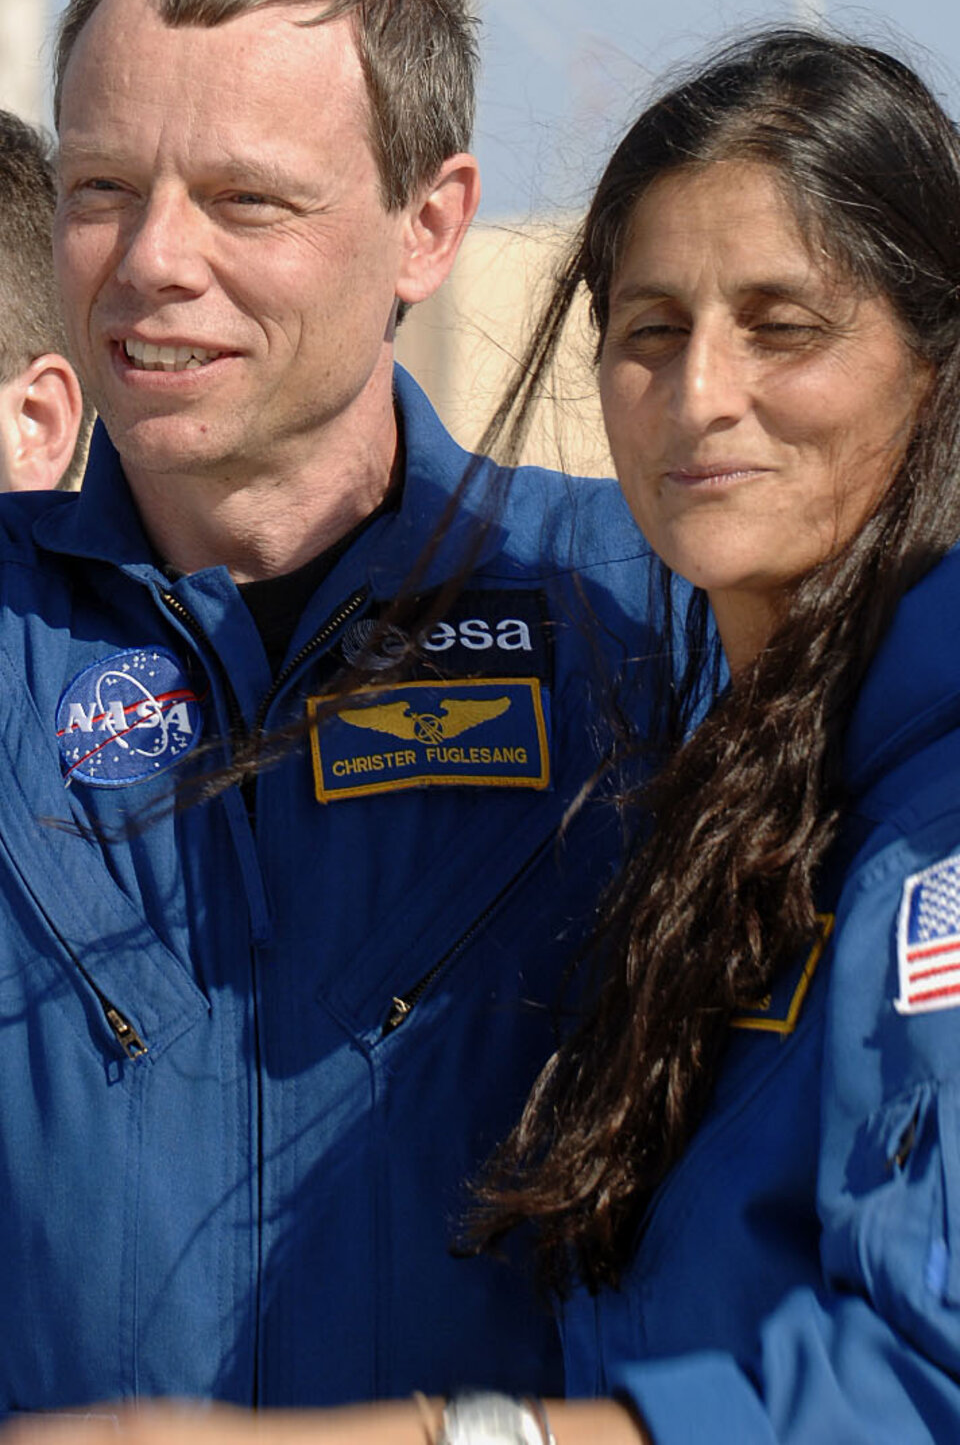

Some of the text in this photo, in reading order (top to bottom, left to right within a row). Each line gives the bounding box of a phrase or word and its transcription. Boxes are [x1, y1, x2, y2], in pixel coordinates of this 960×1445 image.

[420, 619, 533, 651] esa
[65, 701, 193, 734] NASA
[332, 747, 528, 776] CHRISTER FUGLESANG
